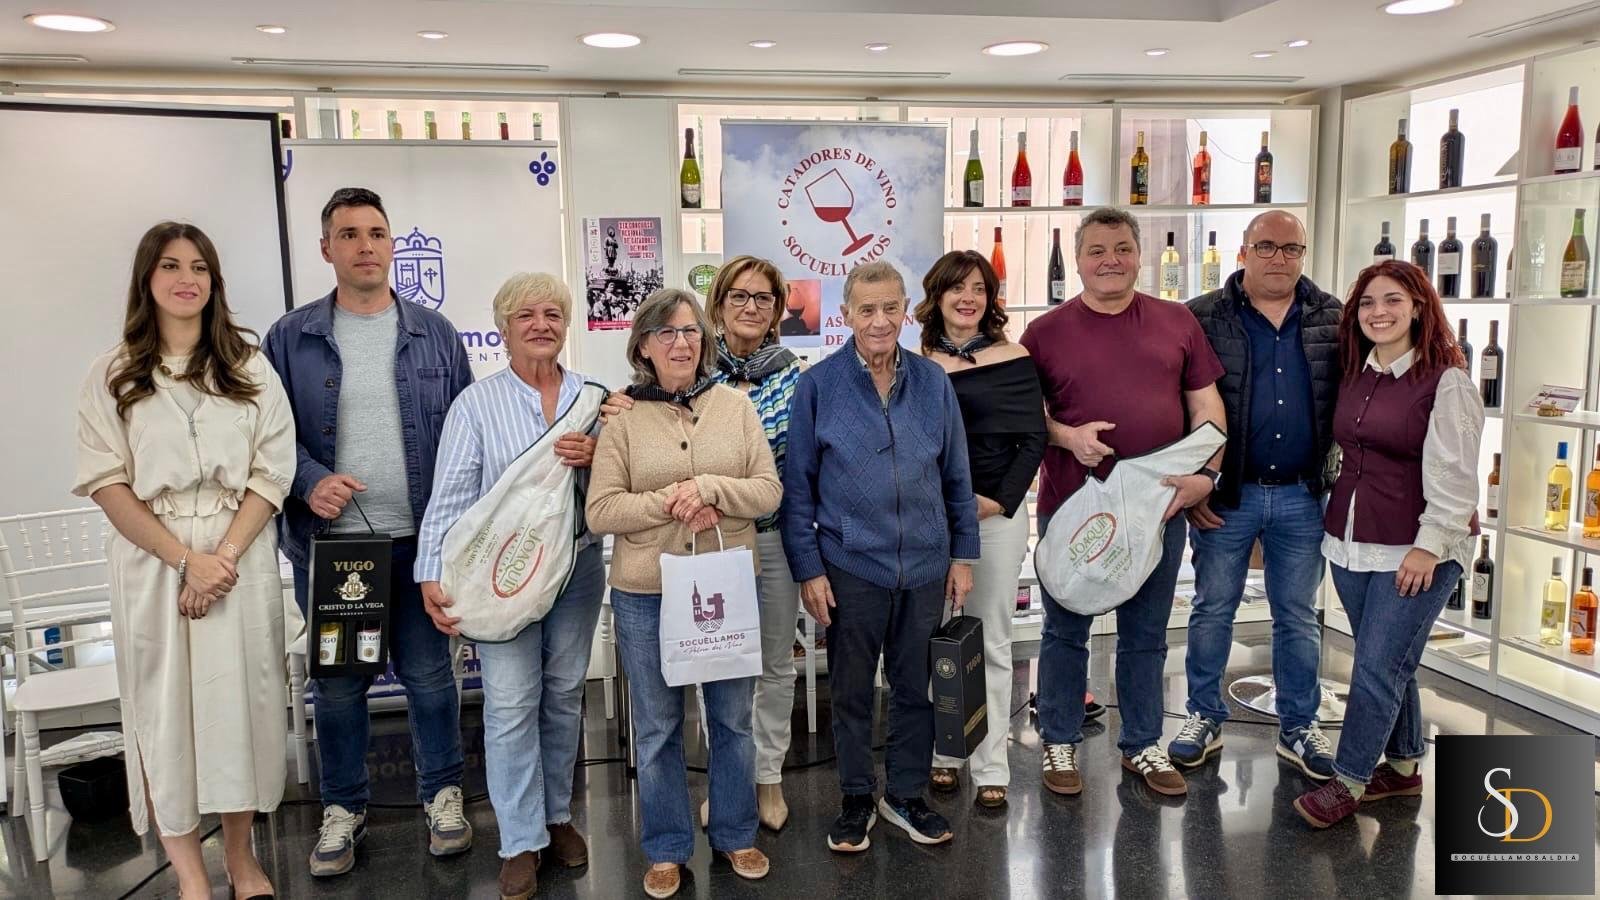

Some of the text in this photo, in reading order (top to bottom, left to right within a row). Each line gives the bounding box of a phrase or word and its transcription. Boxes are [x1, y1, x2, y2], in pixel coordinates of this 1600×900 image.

[777, 147, 897, 209] CATADORES DE VINO
[825, 334, 844, 346] DE
[333, 560, 375, 572] YUGO
[318, 603, 346, 611] CRISTO
